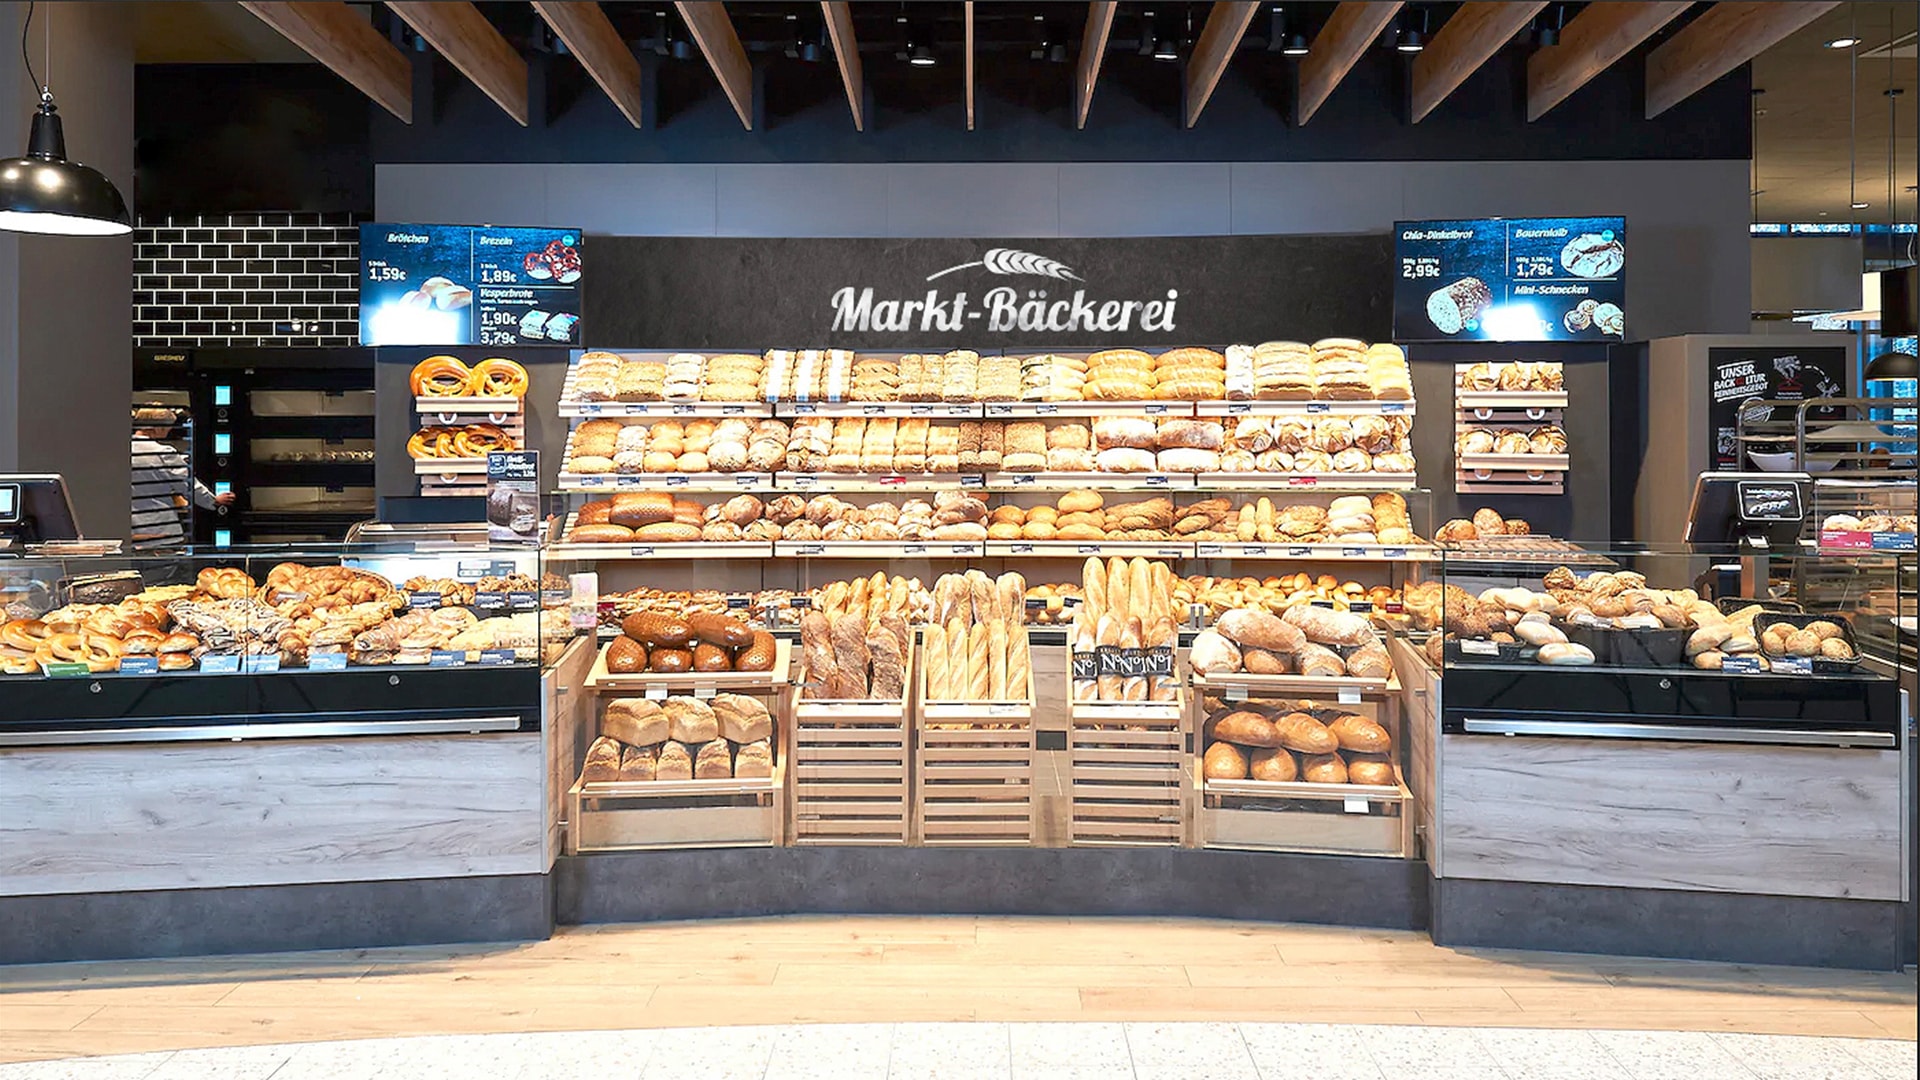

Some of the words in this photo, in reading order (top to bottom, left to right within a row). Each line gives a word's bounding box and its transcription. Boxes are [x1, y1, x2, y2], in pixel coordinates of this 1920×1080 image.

[387, 232, 430, 244] Brötchen
[1402, 229, 1474, 241] Chia-Dinkelbrot
[1515, 228, 1568, 239] Bauernlaib
[480, 236, 514, 246] Brezeln
[369, 267, 406, 282] 1,59€
[481, 270, 517, 283] 1,89€
[1403, 265, 1440, 279] 2,99€
[1516, 263, 1553, 278] 1,79€
[480, 289, 534, 299] Vesperbrote
[1514, 284, 1589, 296] Mini-Schnecken
[831, 286, 1178, 332] Markt-Bäckerei
[1721, 364, 1754, 379] UNSER
